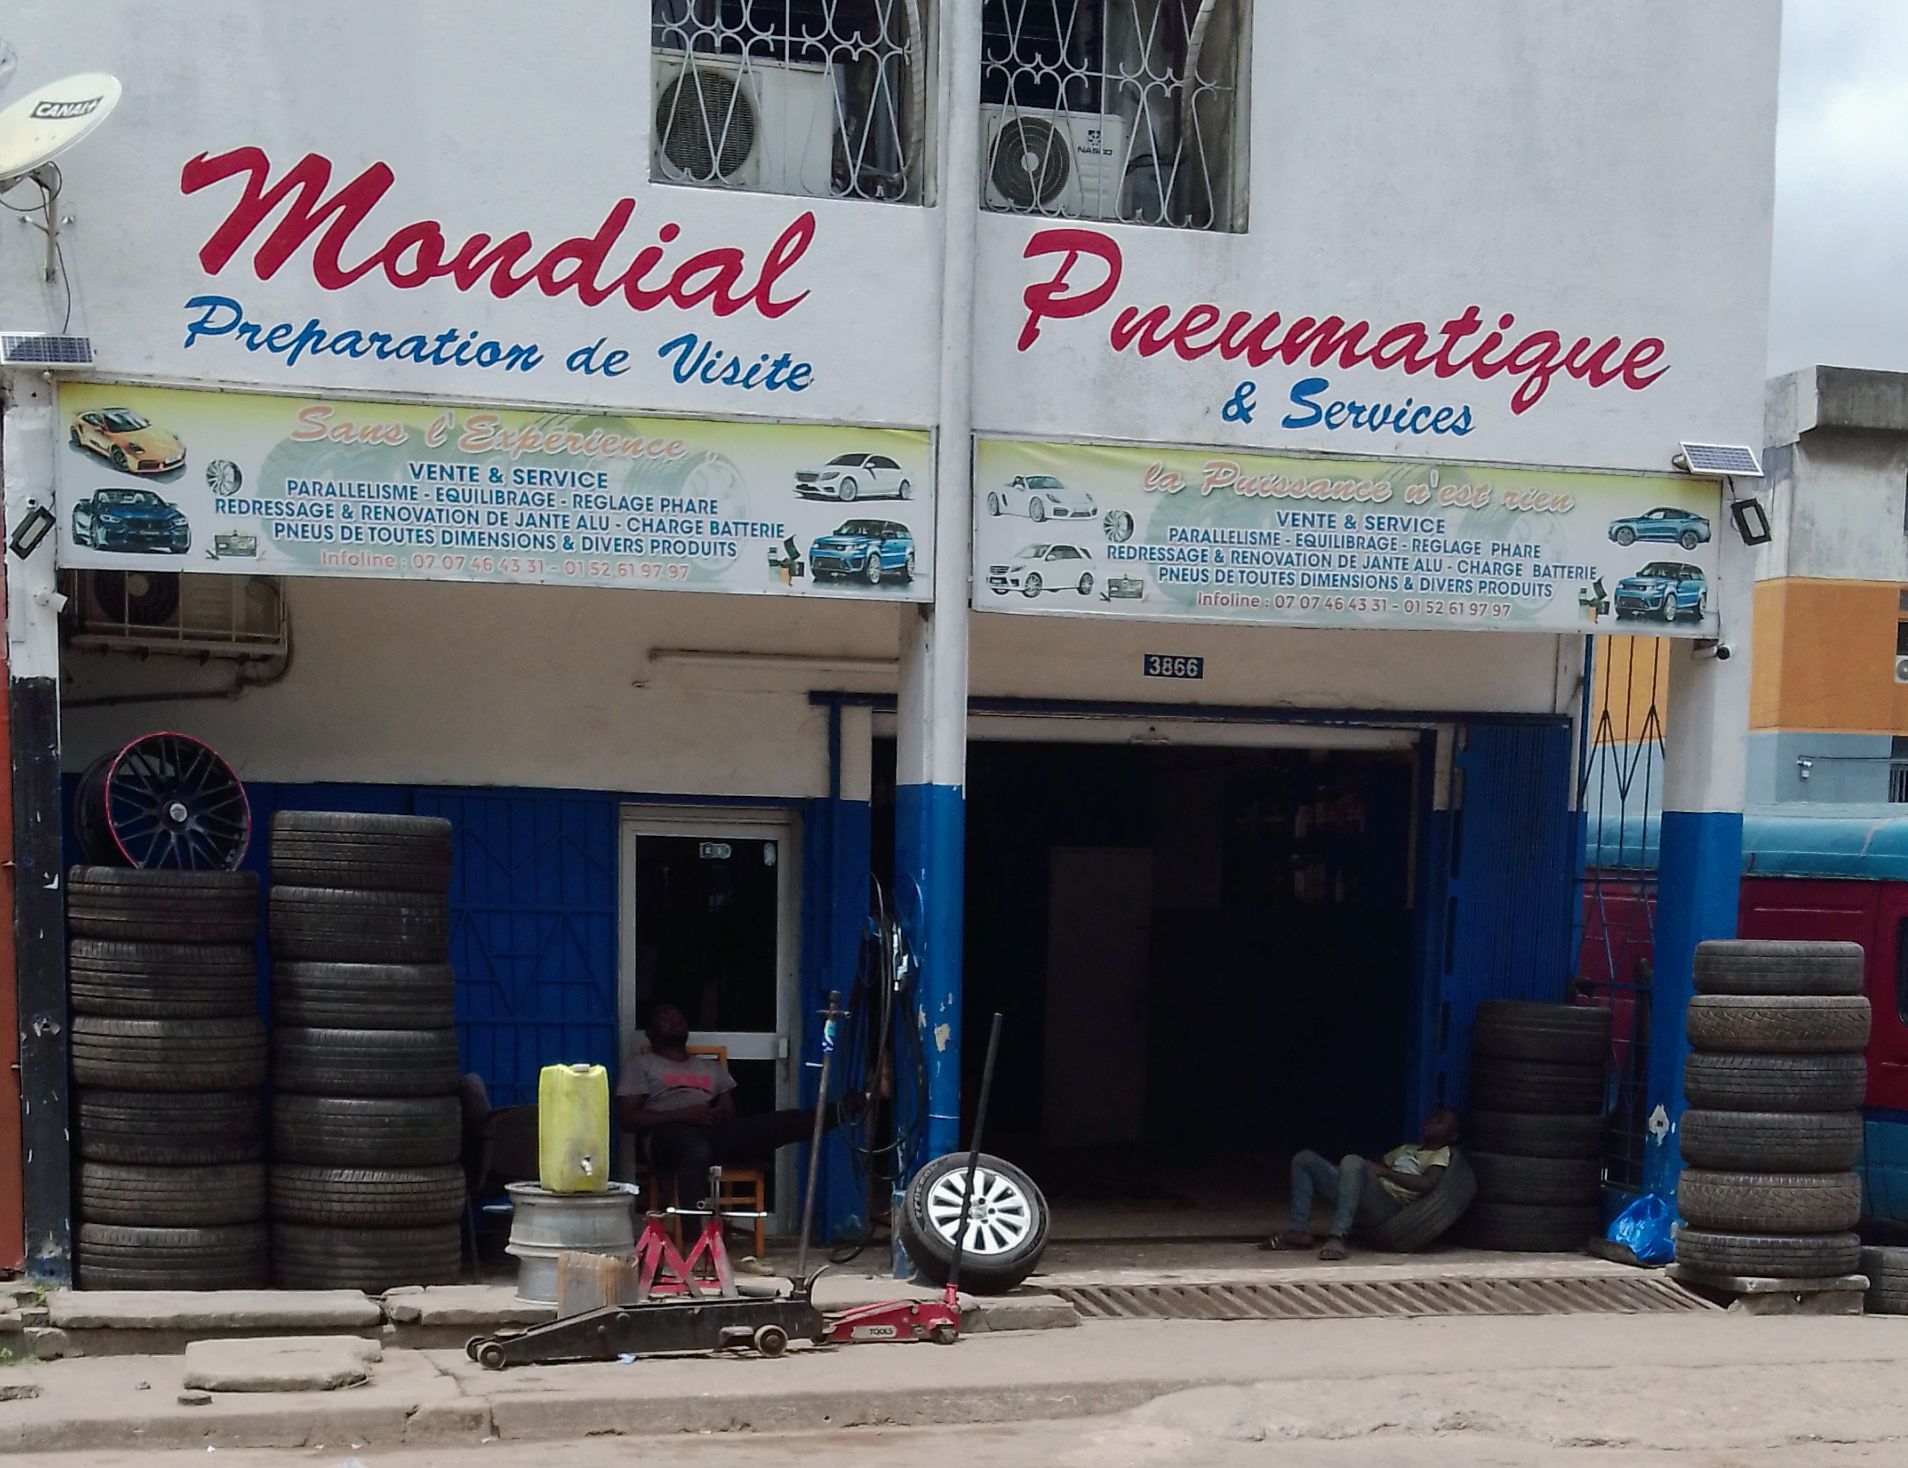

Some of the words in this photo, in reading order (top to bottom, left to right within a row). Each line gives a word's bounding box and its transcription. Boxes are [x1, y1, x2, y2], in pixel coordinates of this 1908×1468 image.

[36, 99, 98, 117] CANAL+
[180, 145, 817, 319] Mondial
[1017, 227, 1670, 415] Pneumatique
[183, 295, 546, 373] Preparation
[567, 336, 631, 376] de
[657, 332, 815, 393] Visite
[1221, 380, 1258, 425] &
[1279, 378, 1476, 436] Services
[291, 405, 408, 446] Sans
[409, 462, 480, 483] VENTE
[488, 466, 503, 484] &
[512, 469, 608, 489] SERVICE
[1143, 460, 1185, 494] la
[1202, 460, 1393, 501] Puissance
[1405, 470, 1493, 509] n'est
[1503, 488, 1575, 513] rien
[287, 480, 418, 501] PARALLELISME
[436, 489, 556, 508] EQUILIBRAGE
[573, 493, 654, 513] REGLAGE
[660, 499, 719, 515] PHARE
[215, 499, 334, 519] REDRESSAGE
[341, 505, 353, 520] &
[362, 506, 479, 526] RENOVATION
[486, 510, 508, 527] DE
[515, 513, 571, 530] JANTE
[576, 515, 610, 532] ALU
[627, 517, 704, 535] CHARGE
[710, 520, 785, 539] BATTERIE
[1277, 511, 1337, 530] VENTE
[1345, 515, 1357, 530] &
[1364, 517, 1445, 534] SERVICE
[274, 523, 334, 542] PNEUS
[341, 525, 364, 542] DE
[368, 526, 435, 546] TOUTES
[441, 530, 556, 551] DIMENSIONS
[563, 535, 574, 551] &
[581, 536, 644, 554] DIVERS
[651, 539, 737, 558] PRODUITS
[1169, 527, 1280, 546] PARALLELISME
[1296, 533, 1397, 551] EQUILIBRAGE
[1412, 539, 1481, 555] REGLAGE
[1492, 543, 1541, 558] PHARE
[321, 550, 396, 569] Infoline
[413, 554, 436, 569] 07
[442, 556, 464, 571] 07
[471, 557, 493, 572] 46
[498, 558, 520, 573] 43
[526, 559, 543, 574] 31
[564, 560, 585, 575] 01
[589, 562, 610, 576] 52
[618, 564, 634, 577] 61
[641, 565, 662, 579] 97
[668, 566, 689, 580] 97
[1107, 545, 1209, 563] REDRESSAGE
[1214, 550, 1225, 563] &
[1231, 551, 1332, 569] RENOVATION
[1338, 554, 1357, 569] DE
[1363, 556, 1409, 571] JANTE
[1414, 558, 1442, 572] ALU
[1457, 560, 1522, 576] CHARGE
[1533, 564, 1597, 580] BATTERIE
[1159, 567, 1209, 583] PNEUS
[1215, 569, 1234, 584] DE
[1239, 570, 1295, 586] TOUTES
[1301, 573, 1398, 590] DIMENSIONS
[1404, 577, 1413, 591] &
[1420, 578, 1473, 594] DIVERS
[1479, 581, 1552, 597] PRODUITS
[1198, 592, 1260, 608] Infoline
[1275, 595, 1294, 608] 07
[1300, 596, 1319, 609] 07
[1324, 596, 1343, 610] 46
[1348, 598, 1366, 611] 43
[1372, 599, 1386, 612] 31
[1404, 600, 1420, 613] 01
[1426, 602, 1443, 614] 52
[1450, 603, 1464, 615] 61
[1469, 603, 1487, 616] 97
[1493, 604, 1510, 617] 97
[1149, 656, 1198, 676] 3866
